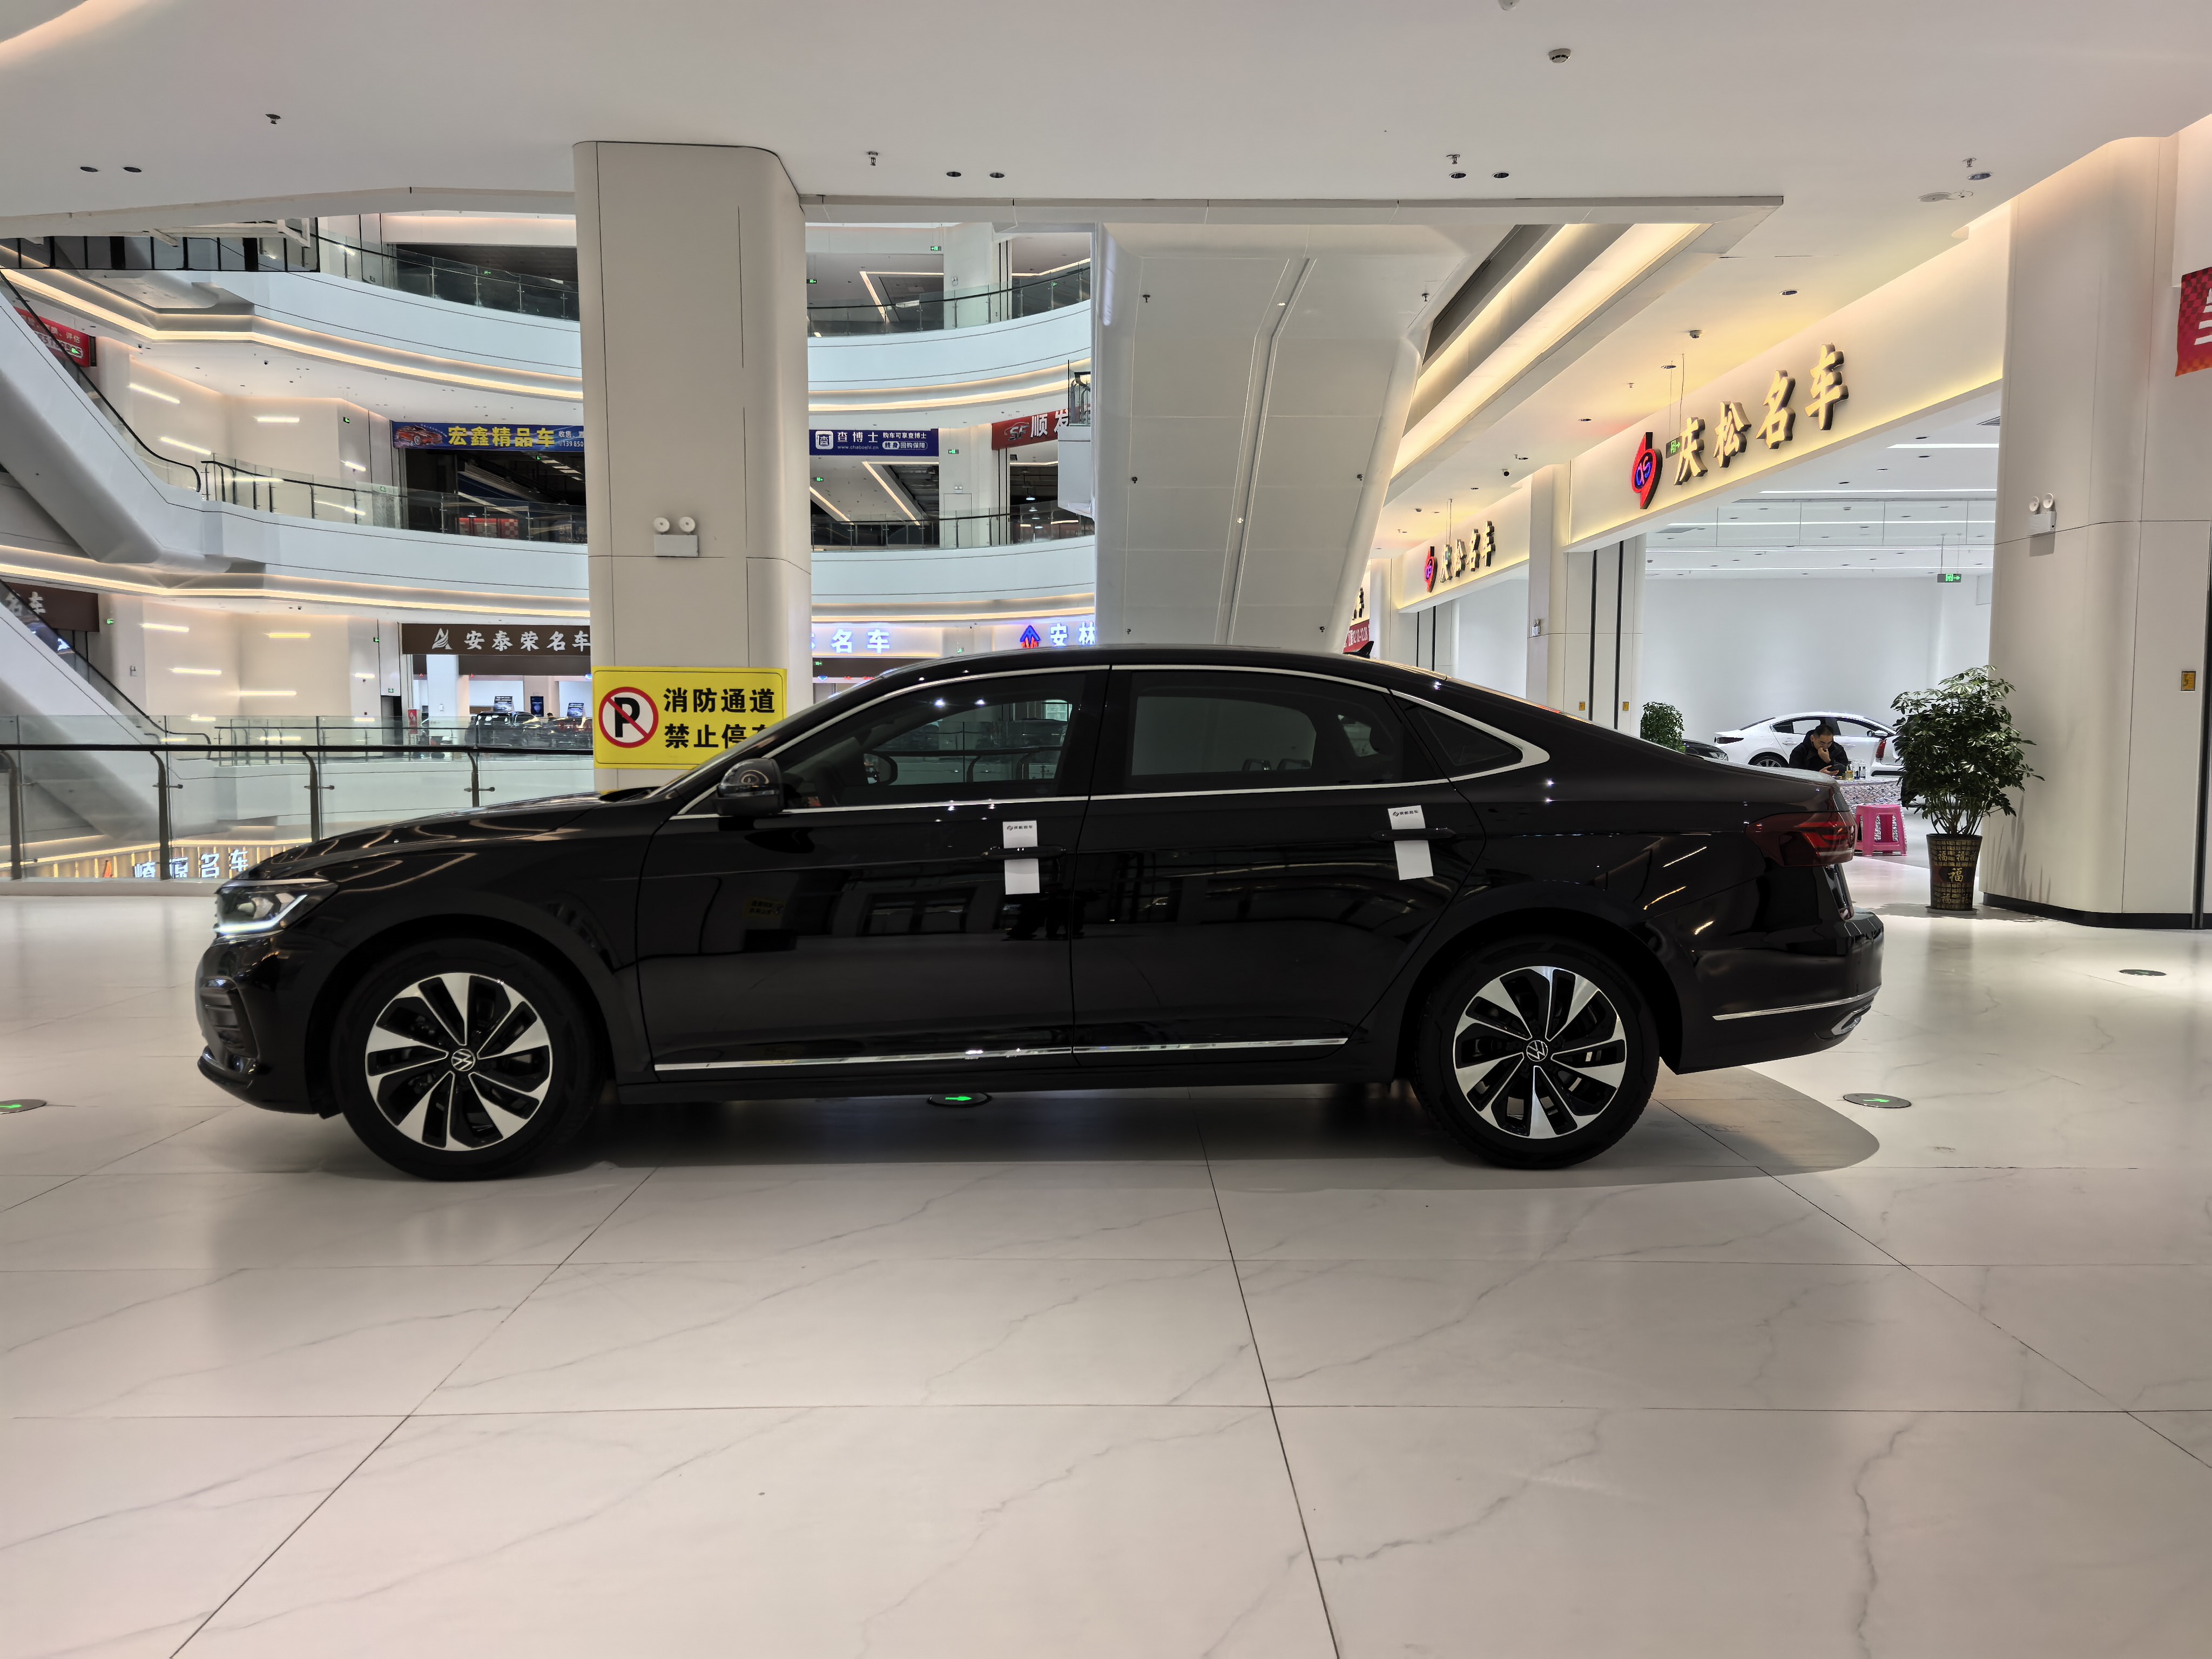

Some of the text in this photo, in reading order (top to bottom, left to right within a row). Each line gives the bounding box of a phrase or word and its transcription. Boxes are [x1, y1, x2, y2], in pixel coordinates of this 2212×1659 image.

[1674, 343, 1850, 485] 庆松名车
[448, 426, 555, 448] 宏鑫精品车
[837, 431, 879, 443] 查博士
[464, 630, 591, 652] 安泰荣名车
[663, 687, 775, 713] 消防通道
[1947, 867, 1964, 882] 福
